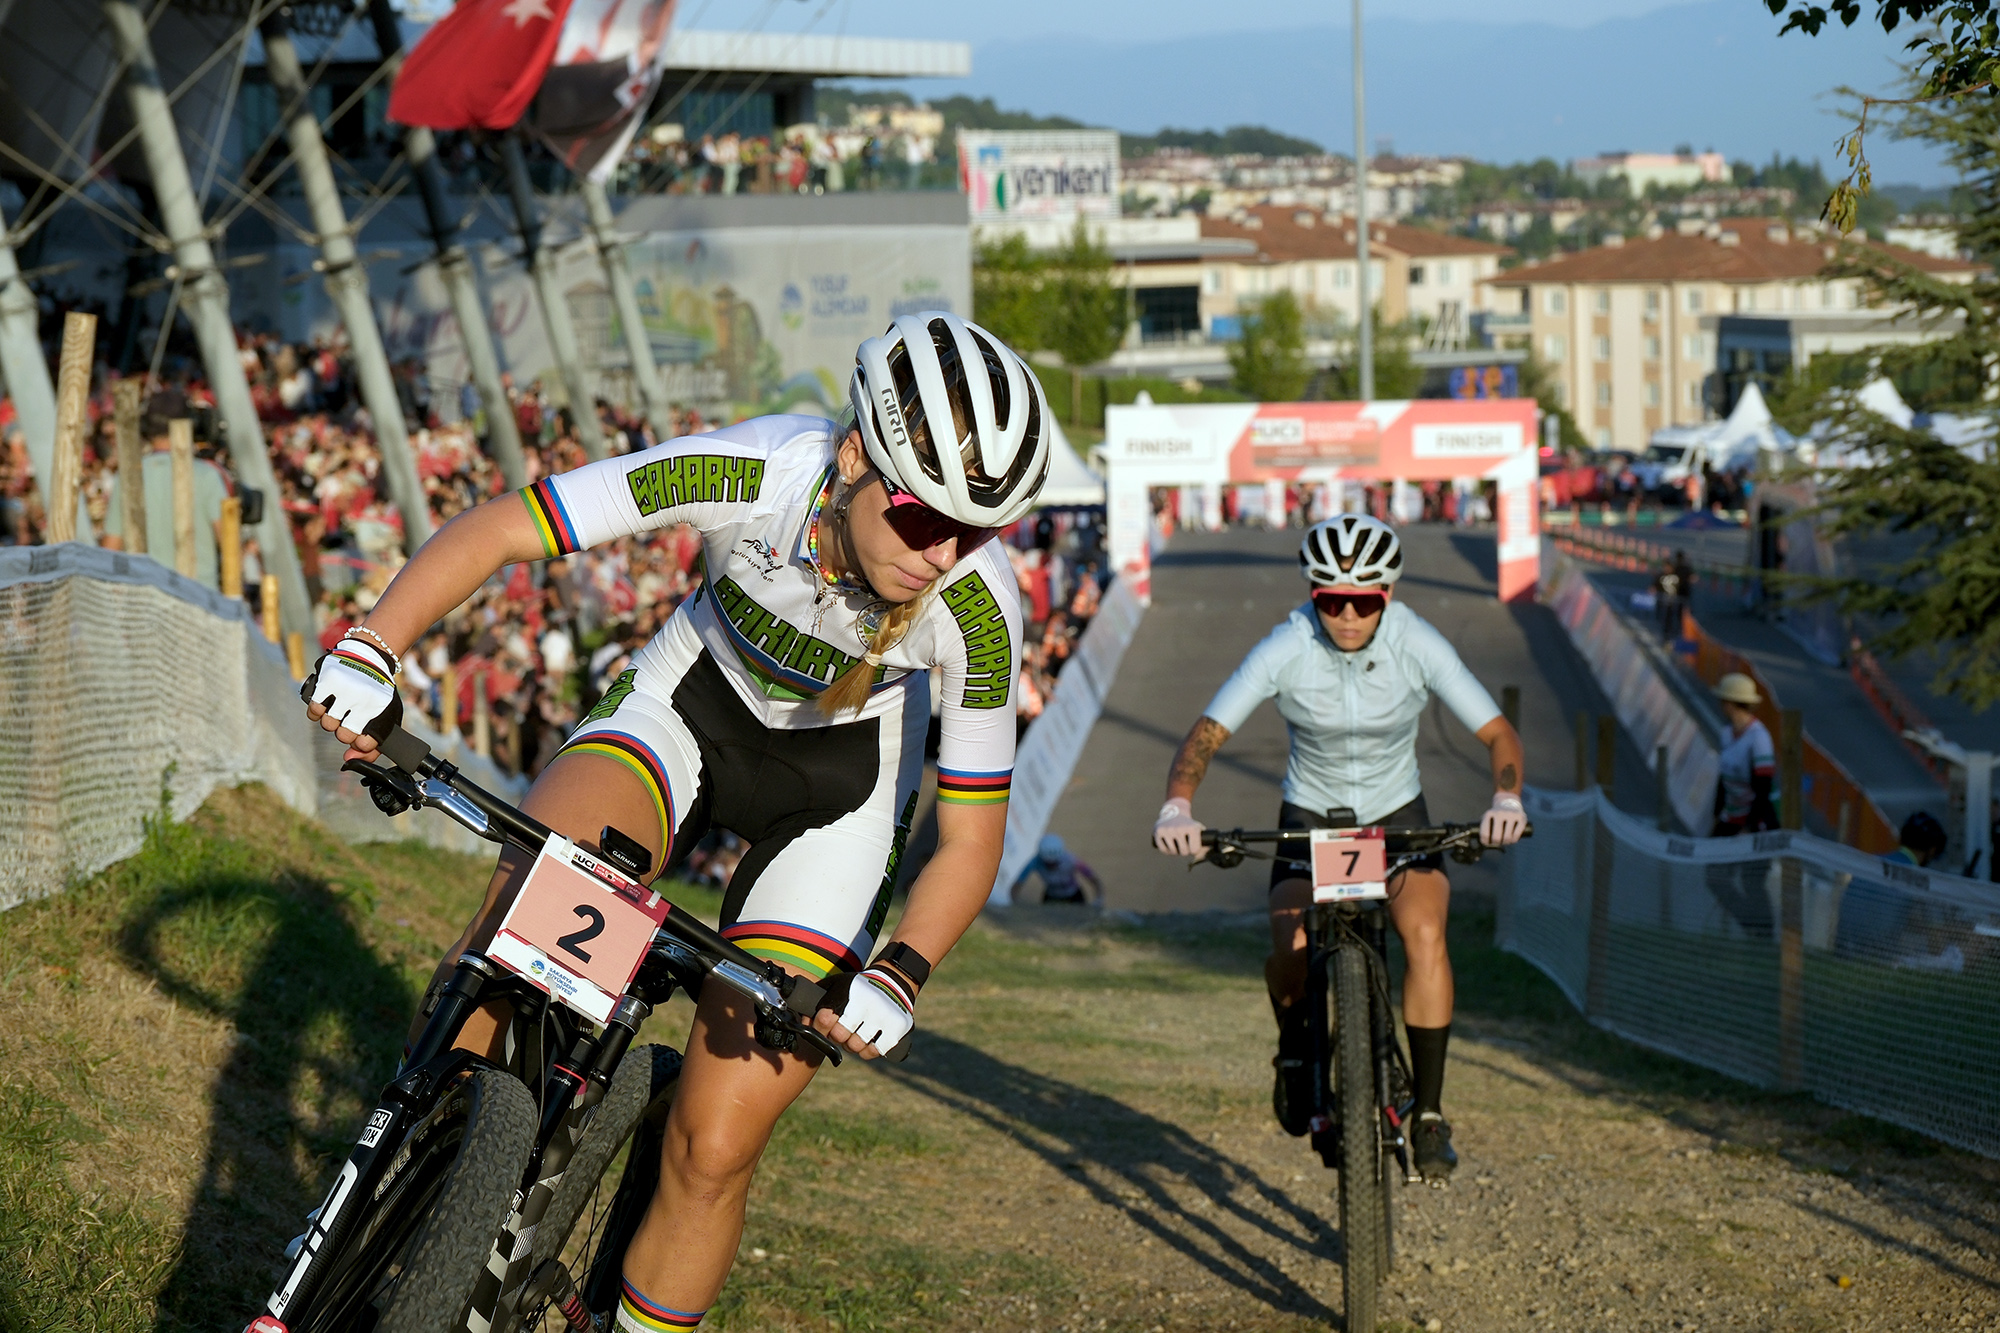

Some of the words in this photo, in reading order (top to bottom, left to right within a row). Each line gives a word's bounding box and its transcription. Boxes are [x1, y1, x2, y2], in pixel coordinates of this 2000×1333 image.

[1125, 437, 1193, 456] FINISH
[1436, 431, 1503, 450] FINISH
[626, 454, 766, 518] SAKARYA
[939, 569, 1012, 709] SAKARYA
[576, 854, 596, 870] UCI
[612, 850, 637, 869] GARMIN
[1341, 851, 1360, 877] 7
[556, 904, 605, 964] 2
[549, 967, 573, 985] SAKARYA
